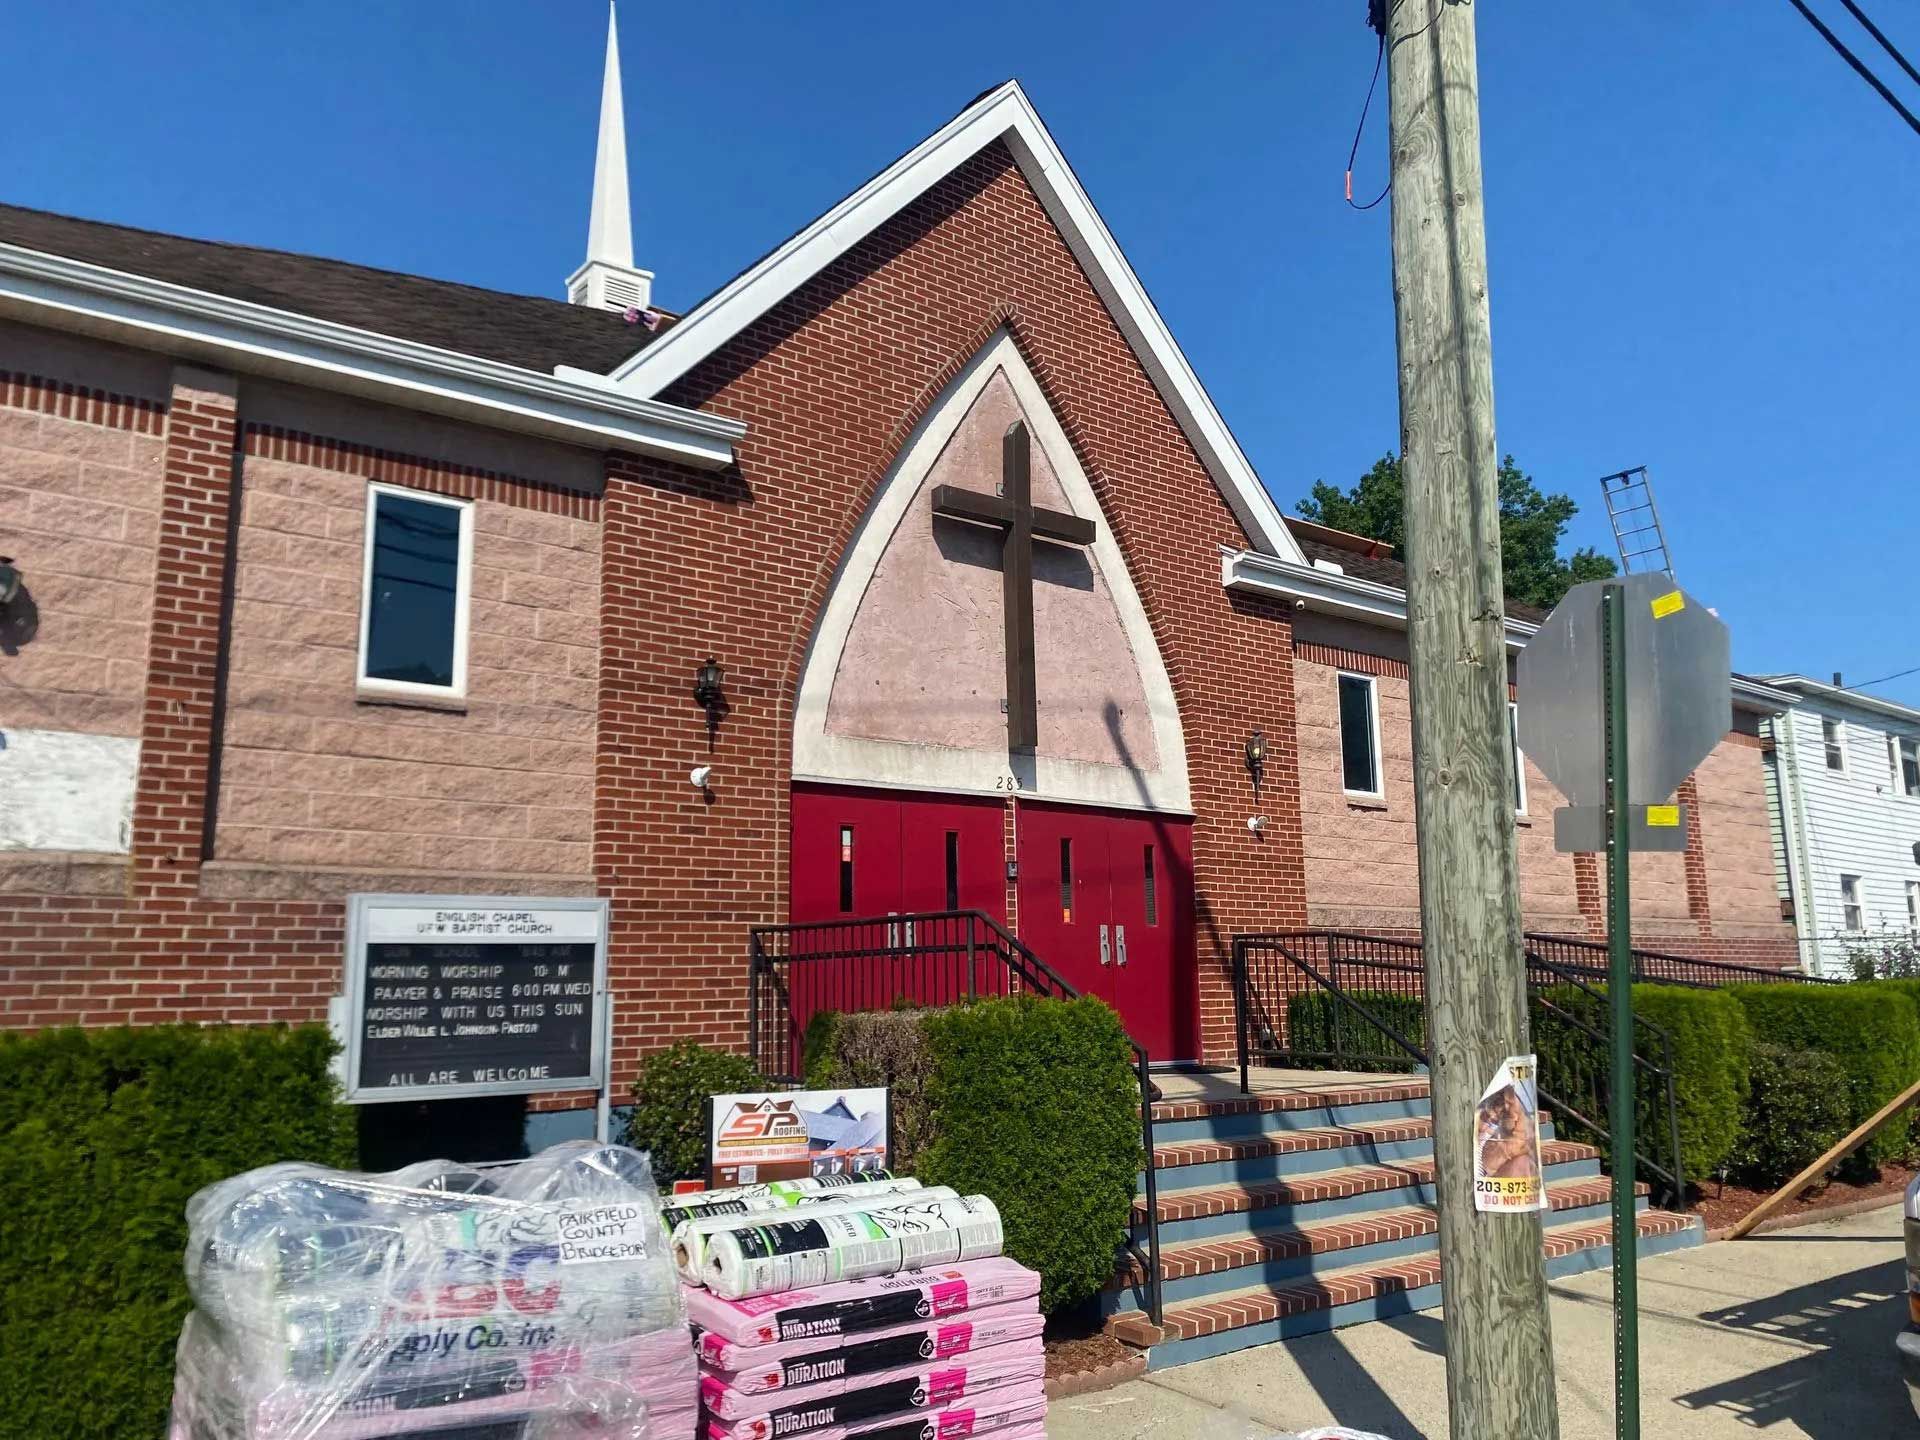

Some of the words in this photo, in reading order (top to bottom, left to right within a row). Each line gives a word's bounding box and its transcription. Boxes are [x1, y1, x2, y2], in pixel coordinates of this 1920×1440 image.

[996, 776, 1023, 791] 285
[436, 912, 486, 922] ENGLISH
[492, 913, 536, 923] CHAPEL
[451, 924, 500, 934] BAPTIST
[507, 924, 552, 934] CHURCH
[440, 965, 504, 979] WORSHIP
[433, 987, 442, 999] &
[451, 986, 504, 999] PRAISE
[512, 984, 539, 997] 6:00
[543, 983, 560, 996] PM
[564, 982, 591, 996] WED
[441, 1006, 476, 1019] WITH
[487, 1005, 506, 1018] US
[512, 1004, 544, 1017] THIS
[555, 1003, 583, 1016] SUN
[389, 1073, 417, 1086] ALL
[427, 1070, 459, 1084] ARE
[473, 1066, 550, 1082] WELCOME
[721, 1112, 799, 1137] SP
[774, 1126, 807, 1137] ROOFING
[1503, 1194, 1522, 1205] NOT
[559, 1207, 637, 1229] FAIRFIELD
[563, 1222, 627, 1239] COUNTY
[465, 1324, 508, 1350] Co.
[781, 1317, 841, 1340] DURATION
[786, 1358, 845, 1386] DURATION
[774, 1407, 836, 1435] DURATION
